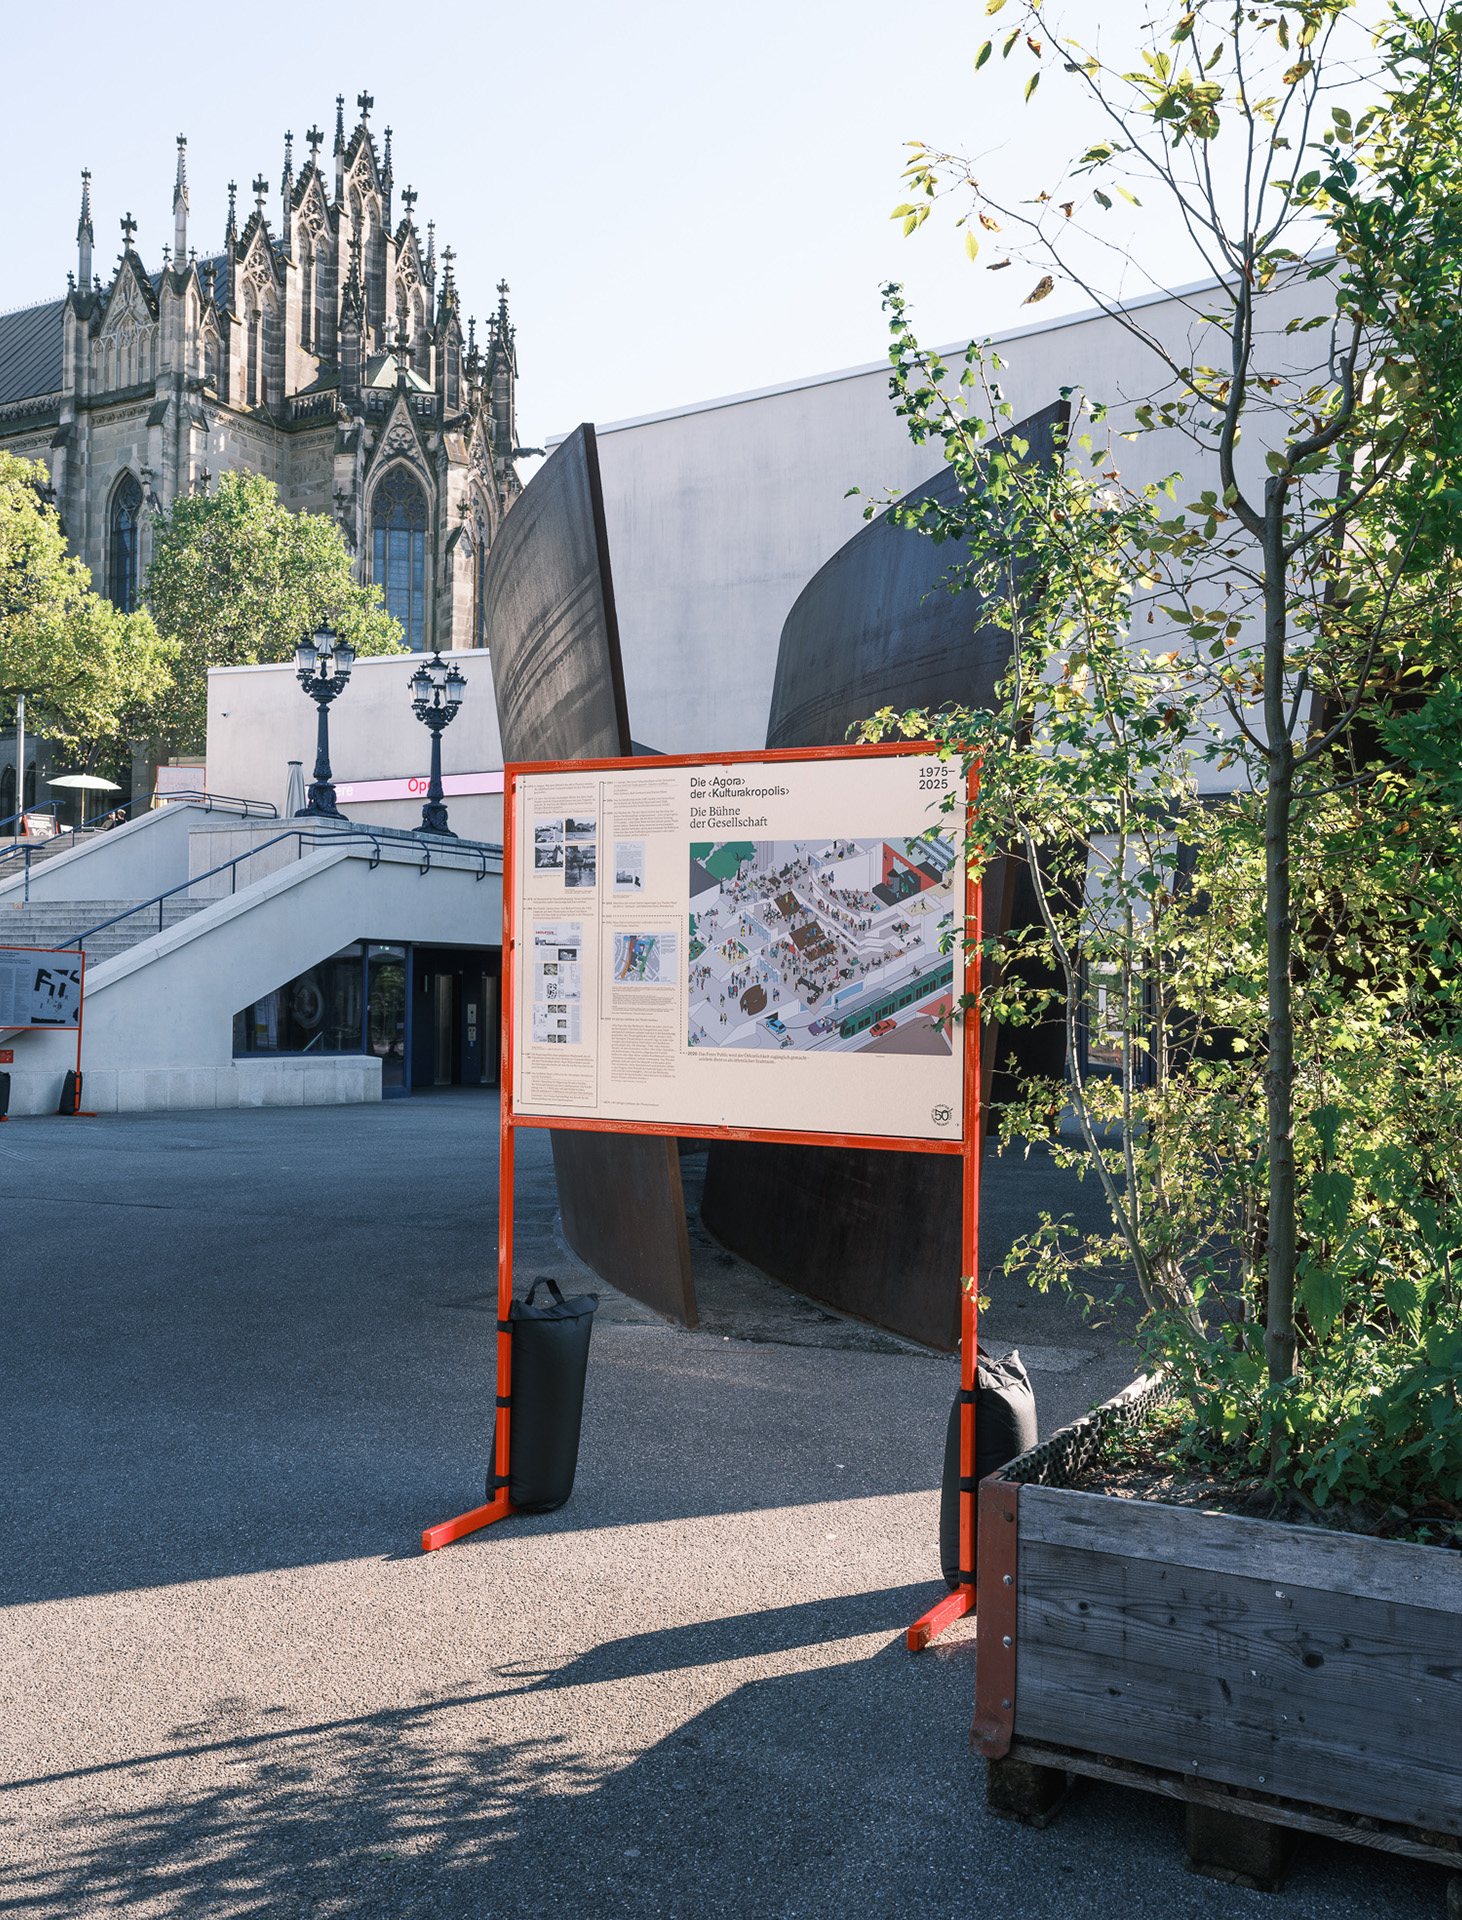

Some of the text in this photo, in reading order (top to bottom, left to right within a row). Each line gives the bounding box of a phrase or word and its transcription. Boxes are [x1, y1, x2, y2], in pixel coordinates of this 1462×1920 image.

[690, 777, 706, 787] Die
[919, 779, 948, 790] 2025
[690, 789, 706, 799] der
[690, 806, 741, 817] Die Bühne
[690, 818, 706, 829] der
[707, 816, 768, 828] Gesellschaft
